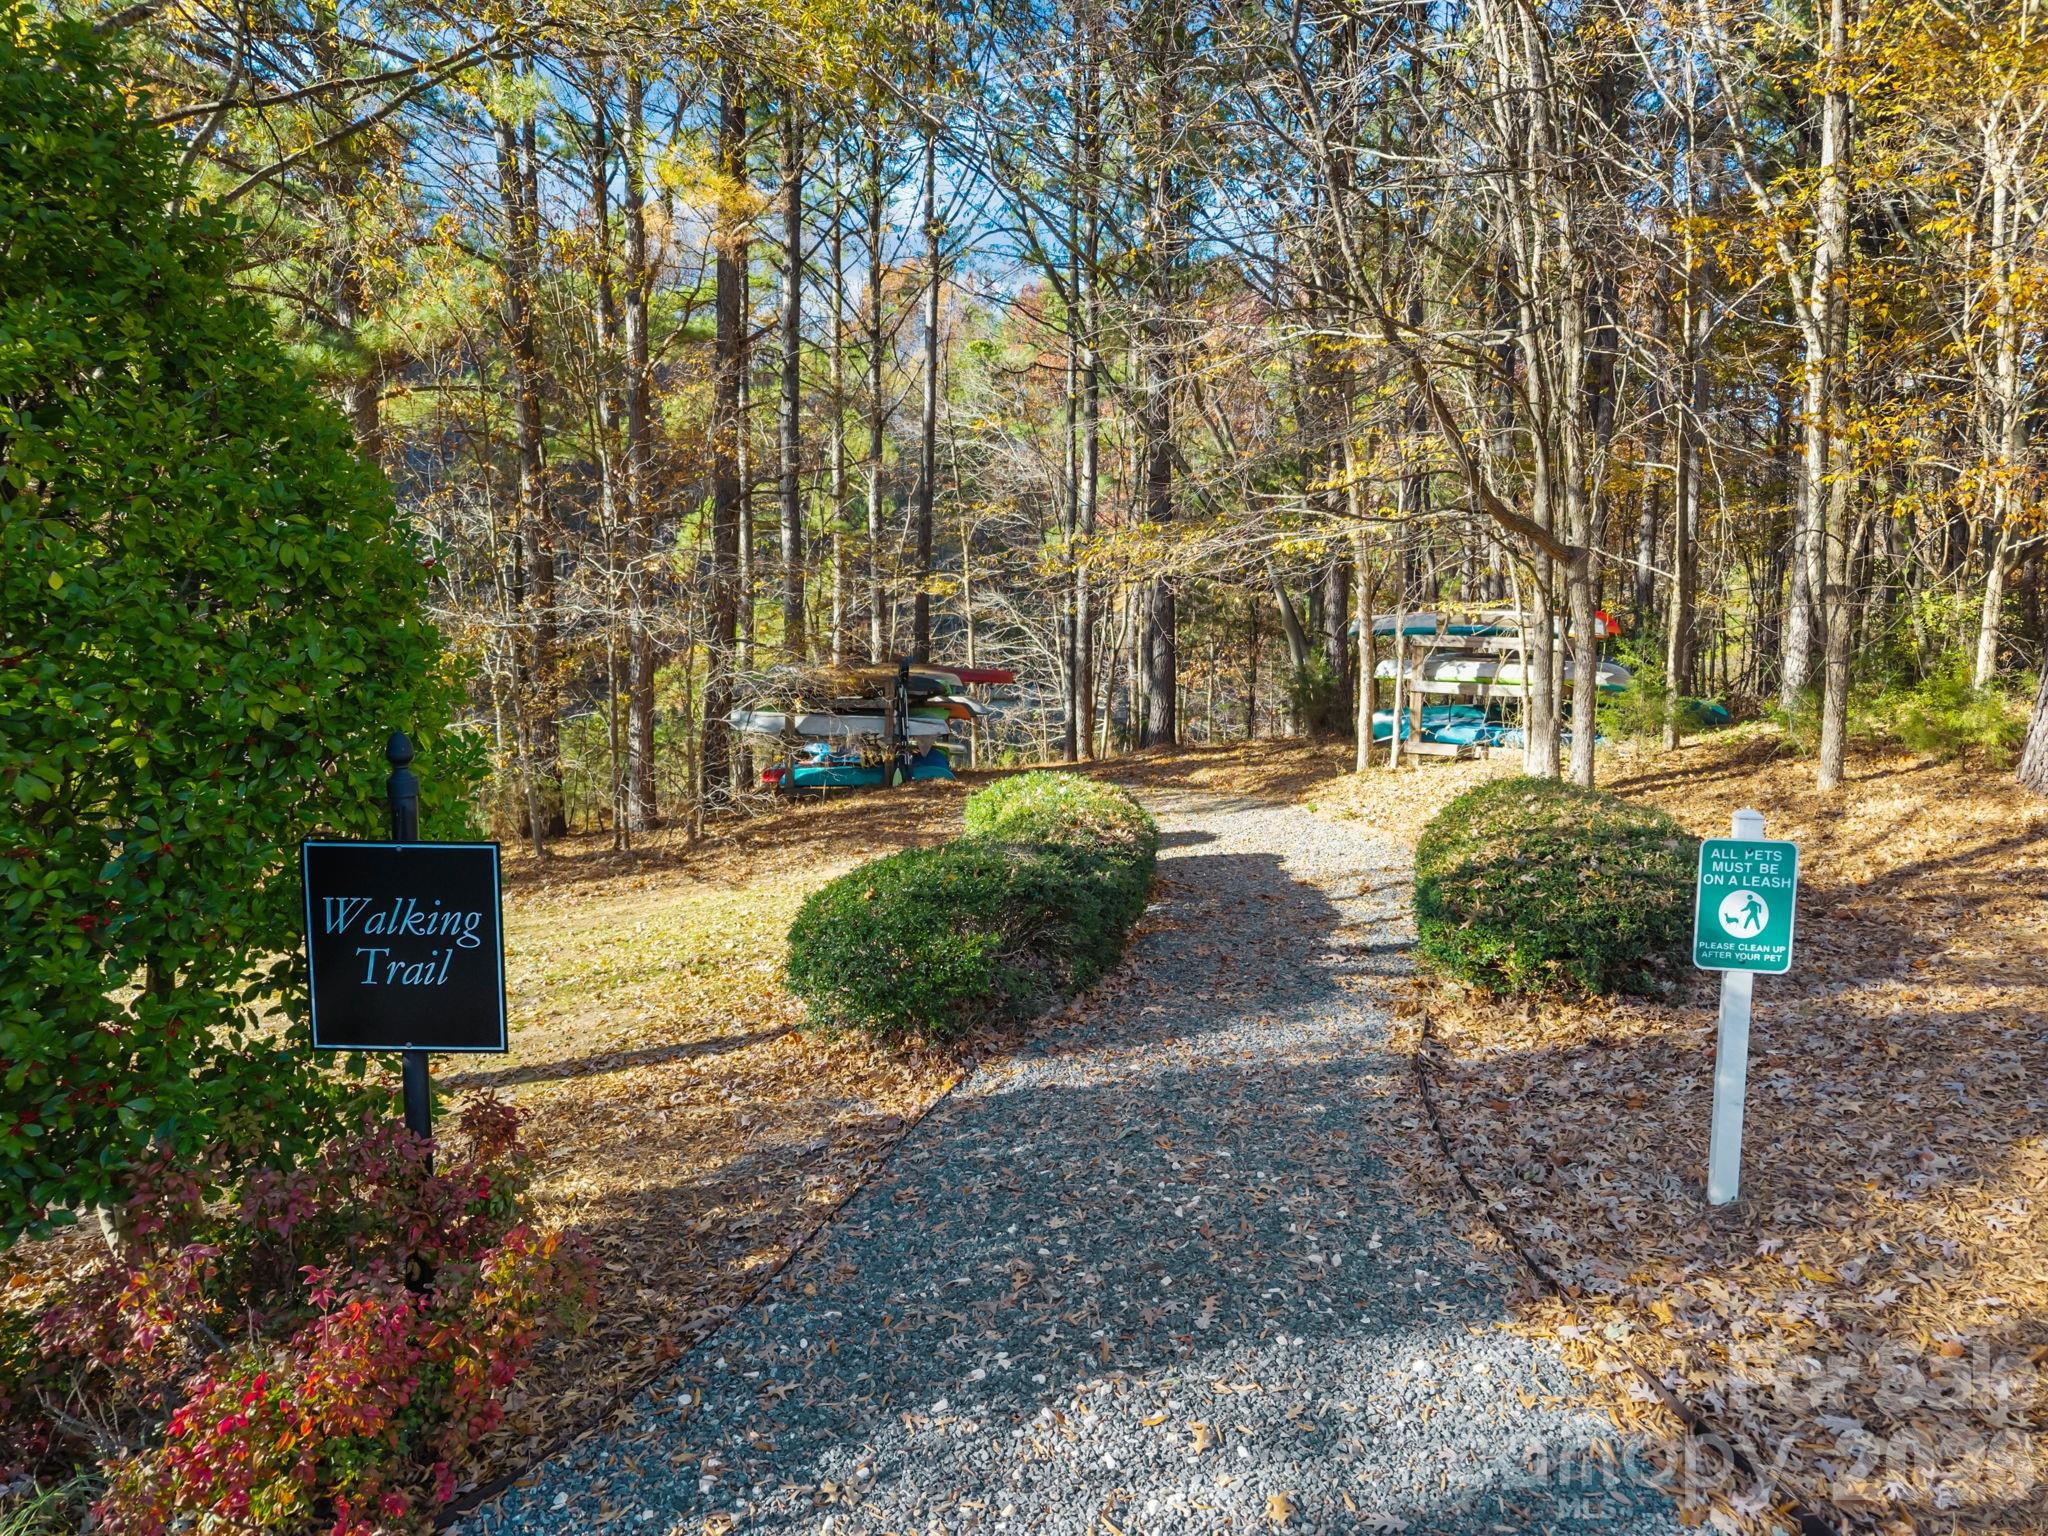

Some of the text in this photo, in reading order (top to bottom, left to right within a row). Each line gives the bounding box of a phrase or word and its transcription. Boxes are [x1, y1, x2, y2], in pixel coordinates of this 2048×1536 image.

[1711, 848, 1783, 862] ALL PETS
[1712, 861, 1779, 875] MUST BE
[1703, 873, 1791, 889] ON A LEASH
[322, 896, 483, 949] Walking
[1699, 941, 1786, 954] PLEASE CLEAN UP
[1701, 950, 1782, 963] AFTER YOUR PET
[355, 946, 454, 986] Trail
